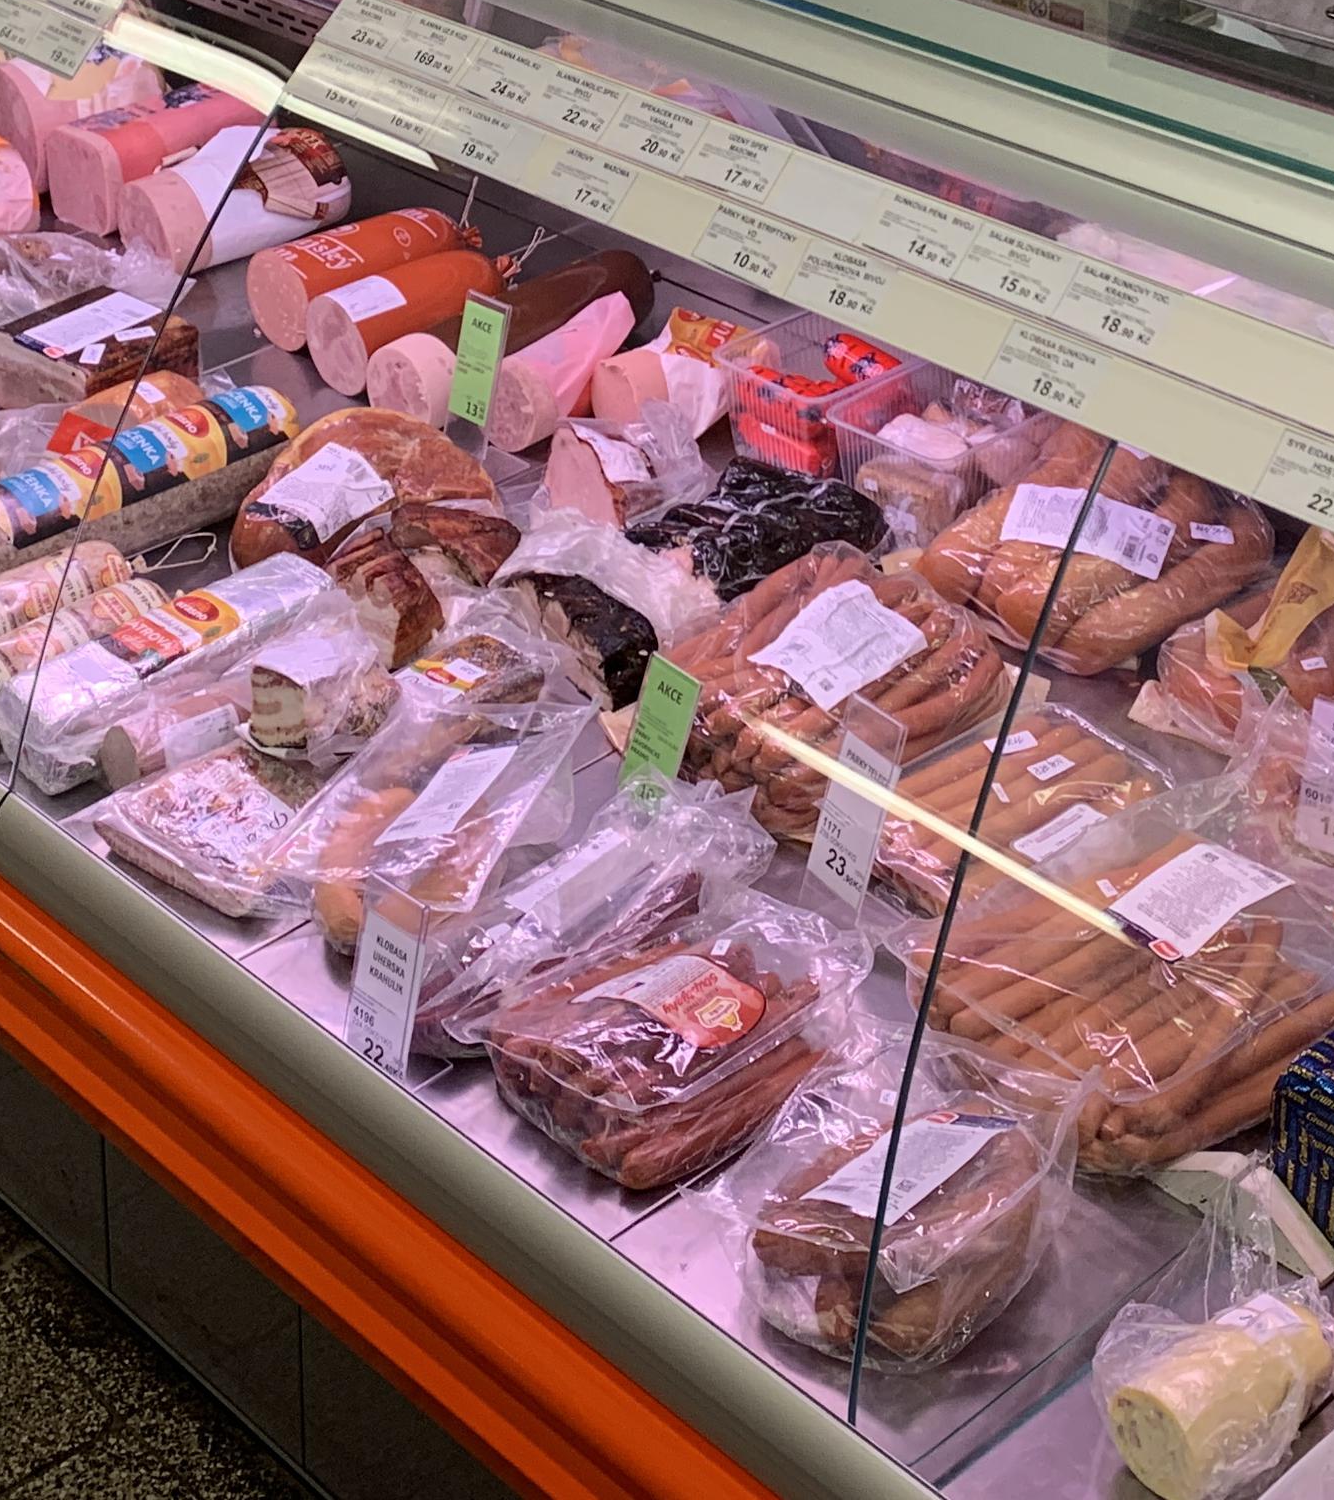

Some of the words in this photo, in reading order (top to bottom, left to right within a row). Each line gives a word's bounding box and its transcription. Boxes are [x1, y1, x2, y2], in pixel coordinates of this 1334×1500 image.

[472, 318, 492, 334] AKCE
[1287, 438, 1306, 452] SYR
[658, 681, 683, 705] AKCE
[822, 816, 842, 838] 1171
[375, 934, 408, 963] KLOBASA
[372, 950, 405, 979] UHERSKA
[369, 965, 404, 996] KRAHULIK
[353, 1004, 375, 1028] 4196
